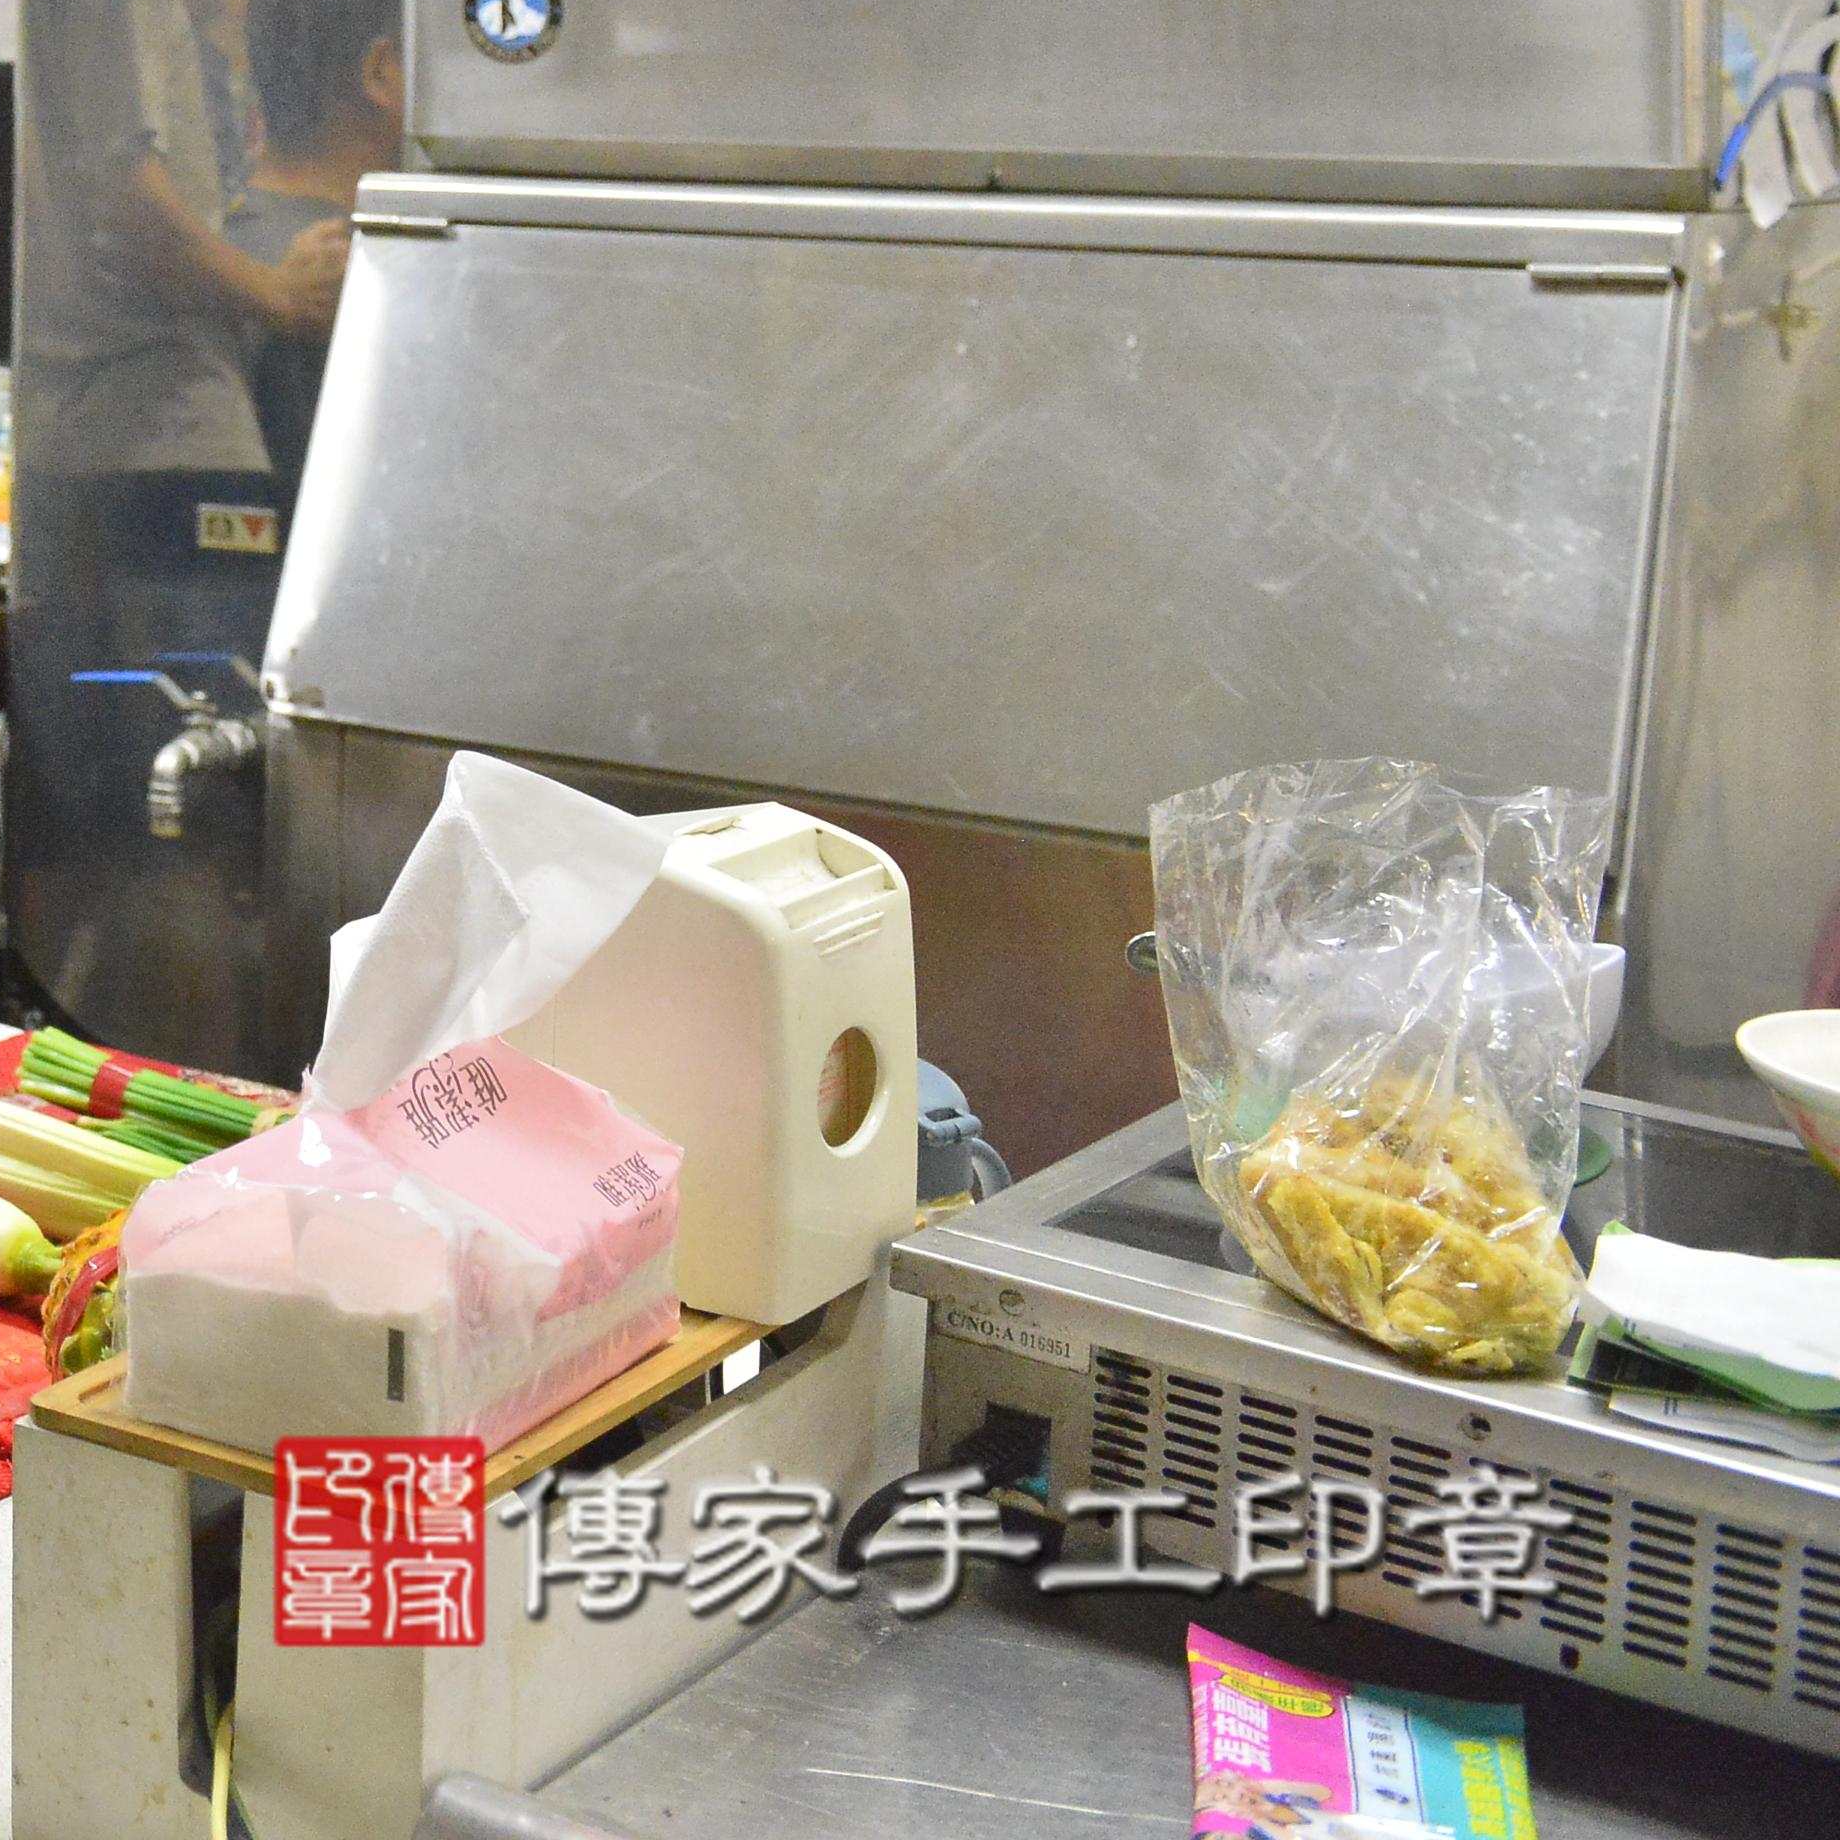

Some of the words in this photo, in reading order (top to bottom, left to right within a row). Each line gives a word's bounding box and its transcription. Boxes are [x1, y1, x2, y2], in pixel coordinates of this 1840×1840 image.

[397, 1053, 508, 1149] 唯潔雅
[592, 1151, 663, 1208] 唯潔雅
